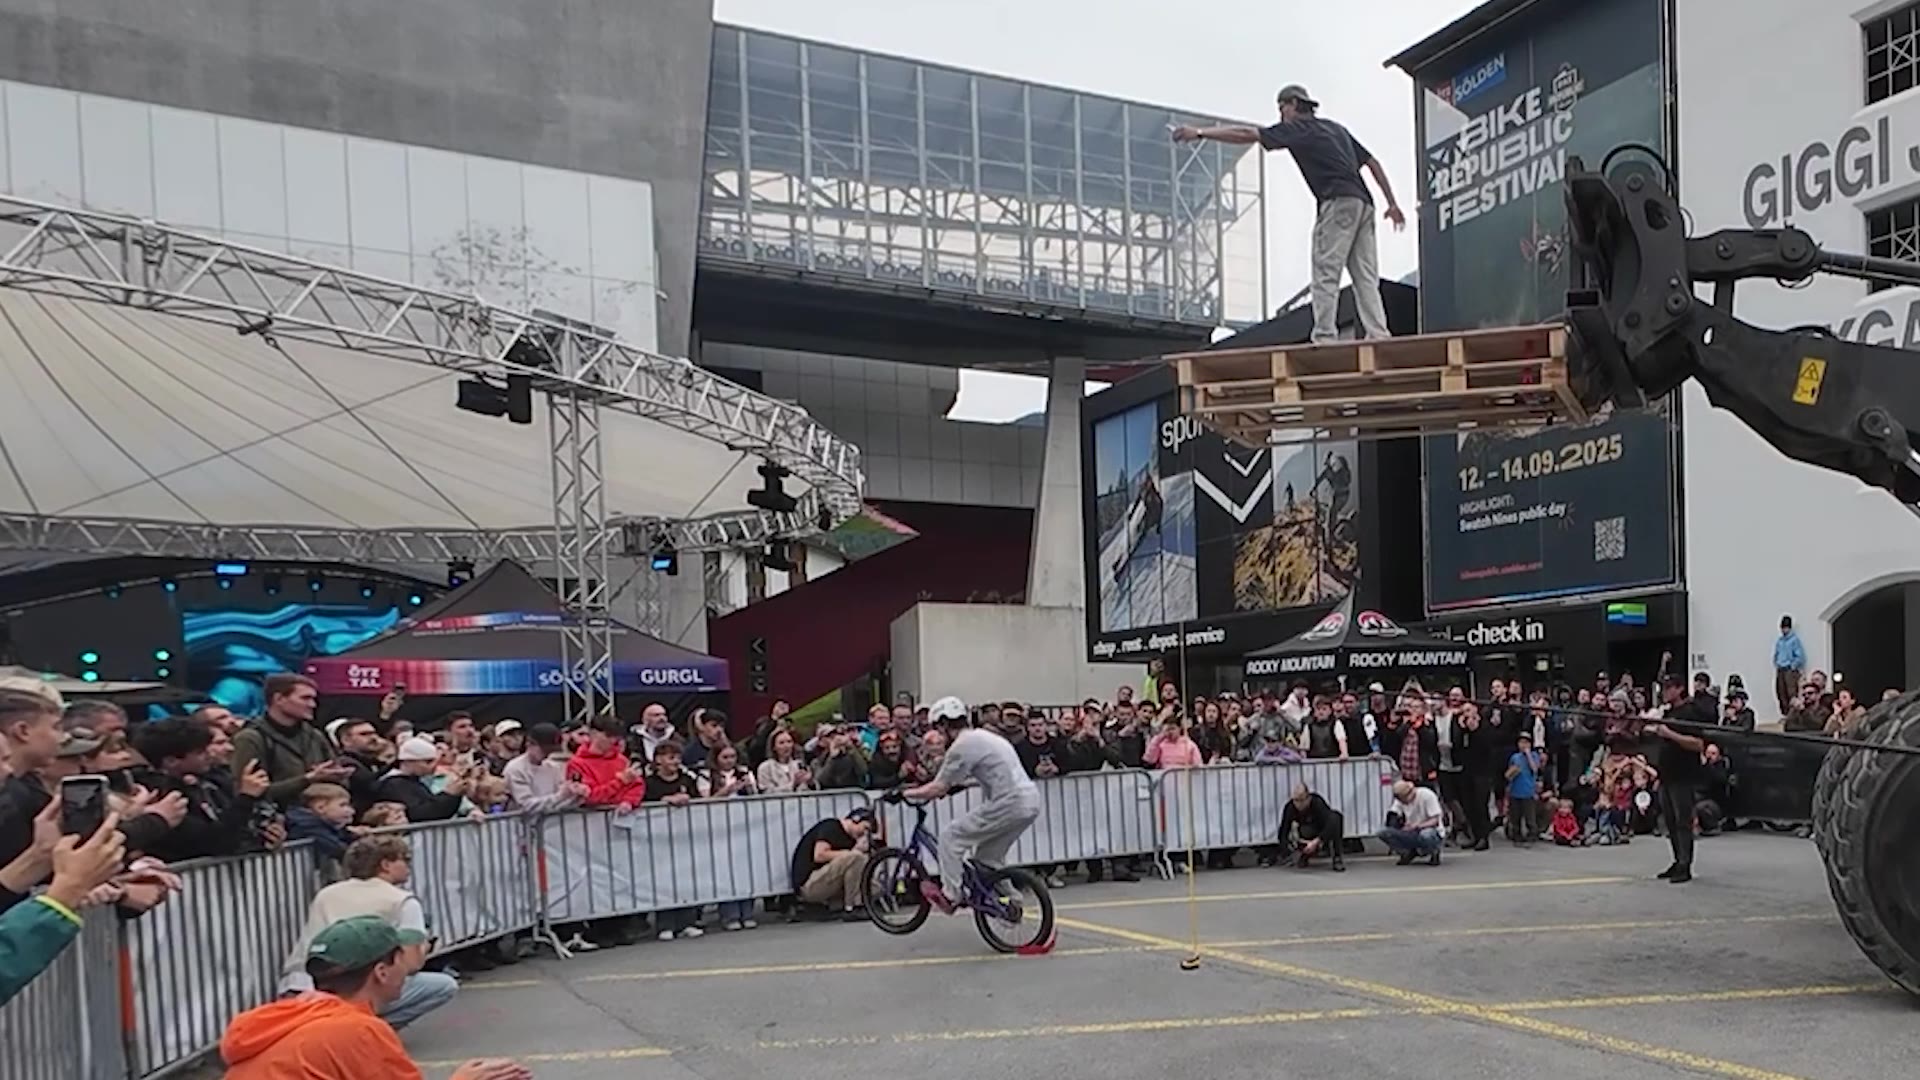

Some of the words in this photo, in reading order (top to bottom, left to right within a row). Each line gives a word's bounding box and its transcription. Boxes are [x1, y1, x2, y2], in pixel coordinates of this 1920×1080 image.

[1455, 53, 1505, 101] SÖLDEN
[1463, 87, 1542, 150] BIKE
[1431, 111, 1573, 199] REPUBLIC
[1743, 115, 1890, 229] GIGGI
[1459, 466, 1484, 491] 12.
[1502, 434, 1623, 482] 14.09.2025
[1519, 504, 1547, 524] public
[1548, 502, 1567, 517] day
[1467, 622, 1523, 646] check
[1525, 617, 1544, 641] in
[1246, 659, 1280, 674] ROCKY
[1280, 655, 1335, 673] MOUNTAIN
[1350, 653, 1397, 667] ROCKY
[1398, 651, 1468, 667] MOUNTAIN
[349, 678, 382, 688] TAL
[640, 669, 704, 684] GURGL
